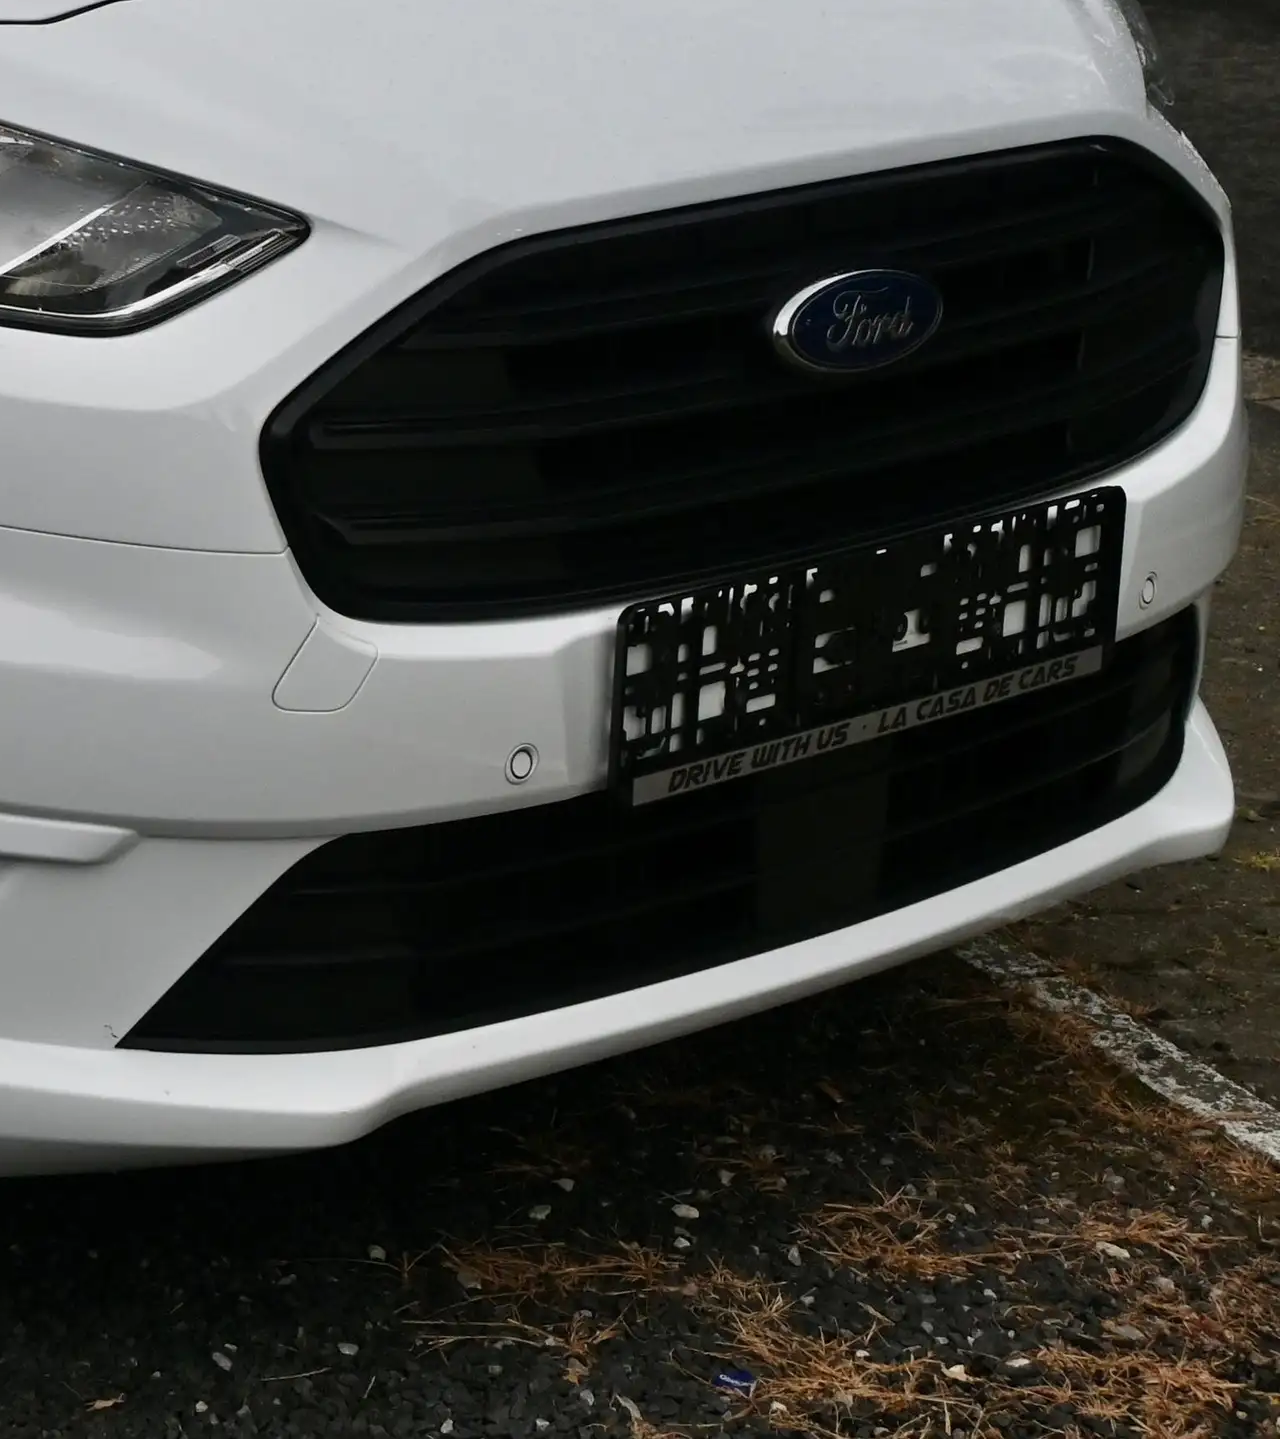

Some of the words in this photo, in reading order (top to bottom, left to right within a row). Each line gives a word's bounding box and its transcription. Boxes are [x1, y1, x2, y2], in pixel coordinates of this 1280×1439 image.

[826, 286, 914, 352] Ford
[668, 751, 745, 793] DRIVE
[751, 732, 811, 769] WITH
[816, 722, 851, 748] US
[877, 706, 907, 733] LA
[915, 686, 976, 720] CASA
[982, 673, 1014, 702] DE
[1017, 655, 1080, 689] CARS
